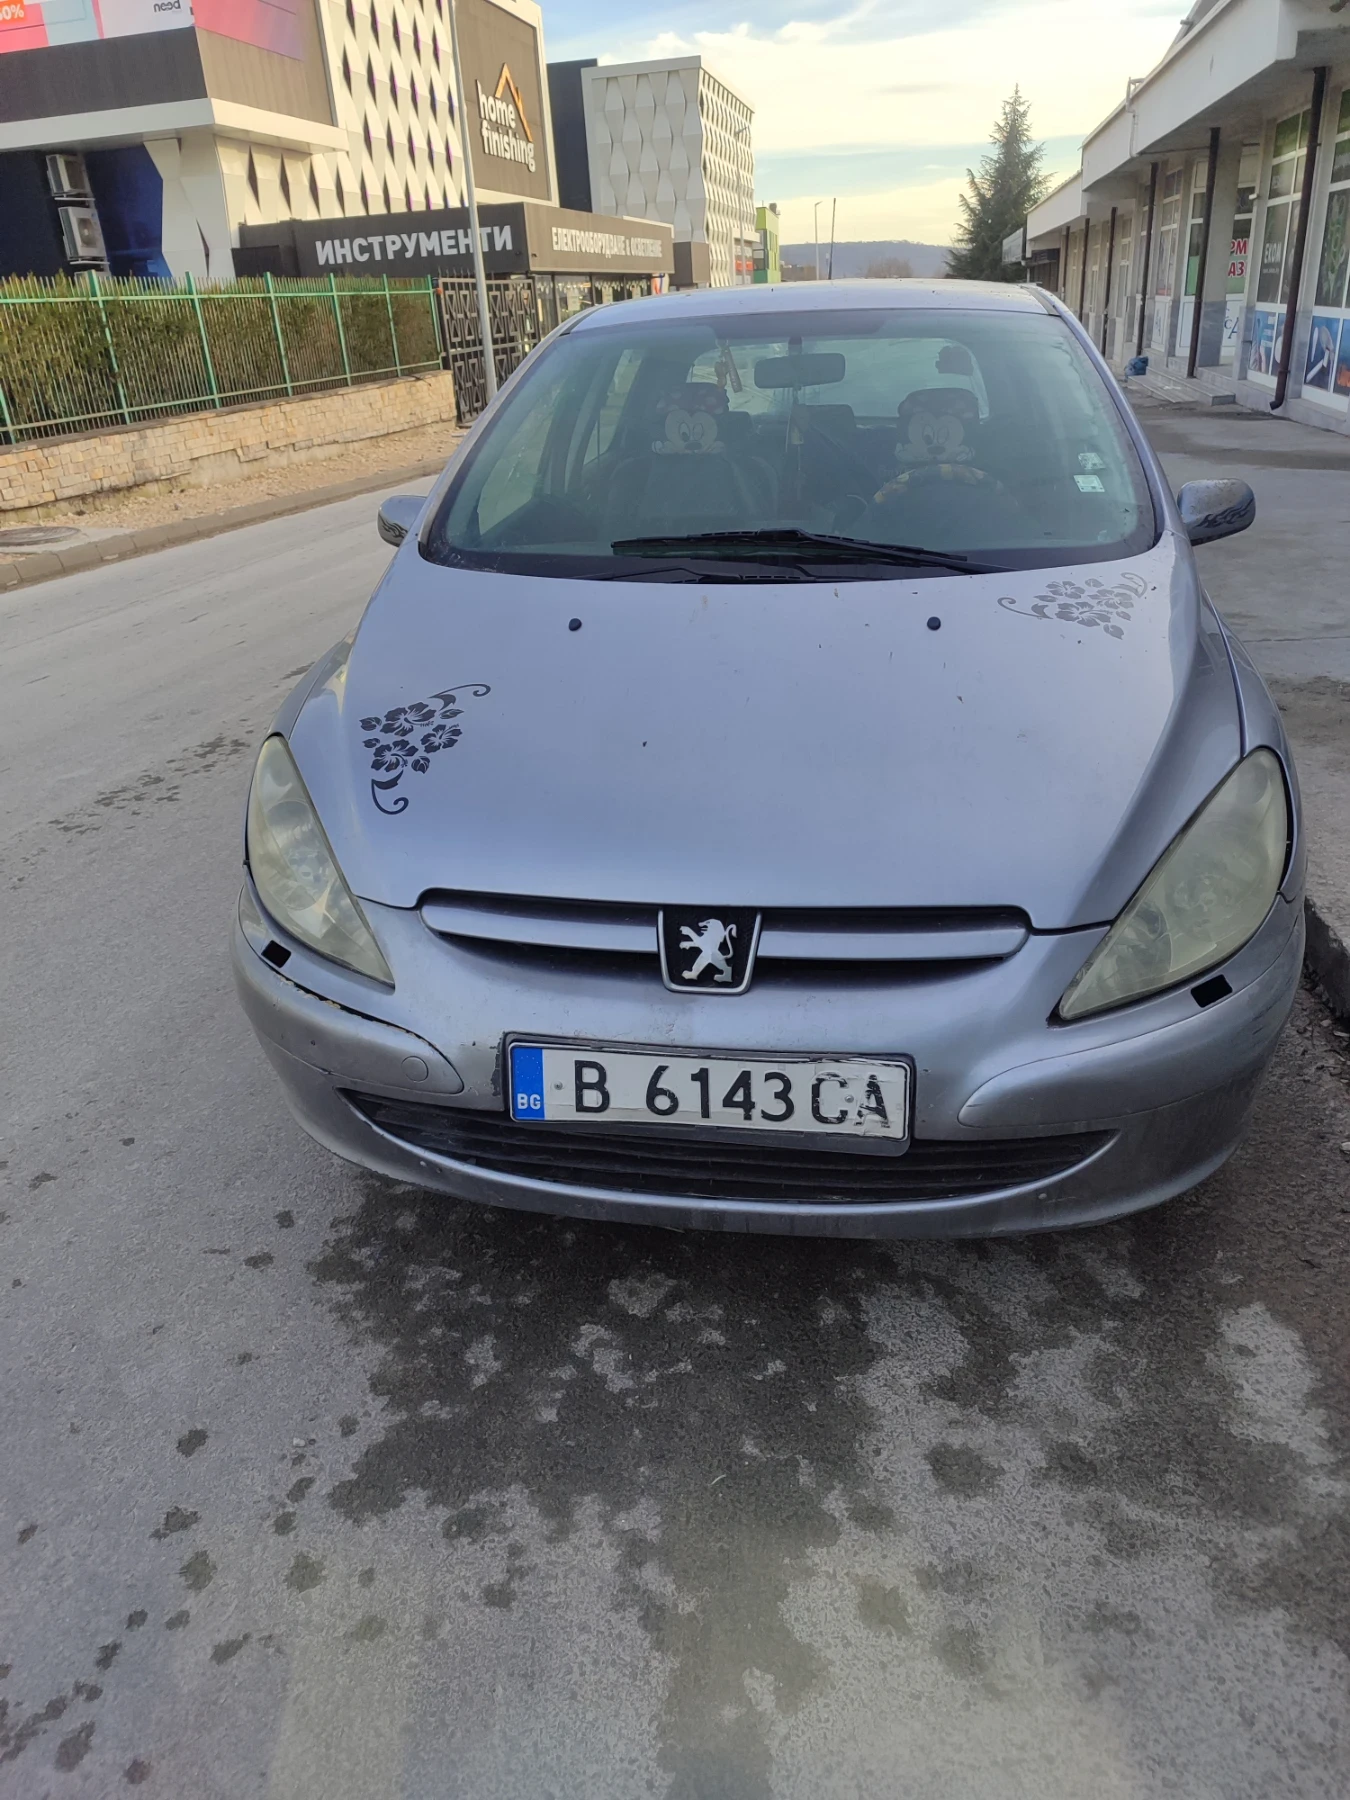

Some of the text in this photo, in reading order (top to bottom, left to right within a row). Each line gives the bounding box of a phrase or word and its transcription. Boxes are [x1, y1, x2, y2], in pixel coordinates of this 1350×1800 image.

[476, 79, 516, 128] home
[481, 120, 536, 172] finishing
[315, 225, 513, 265] ИНСТРУМЕНТИ
[516, 1093, 541, 1111] BG
